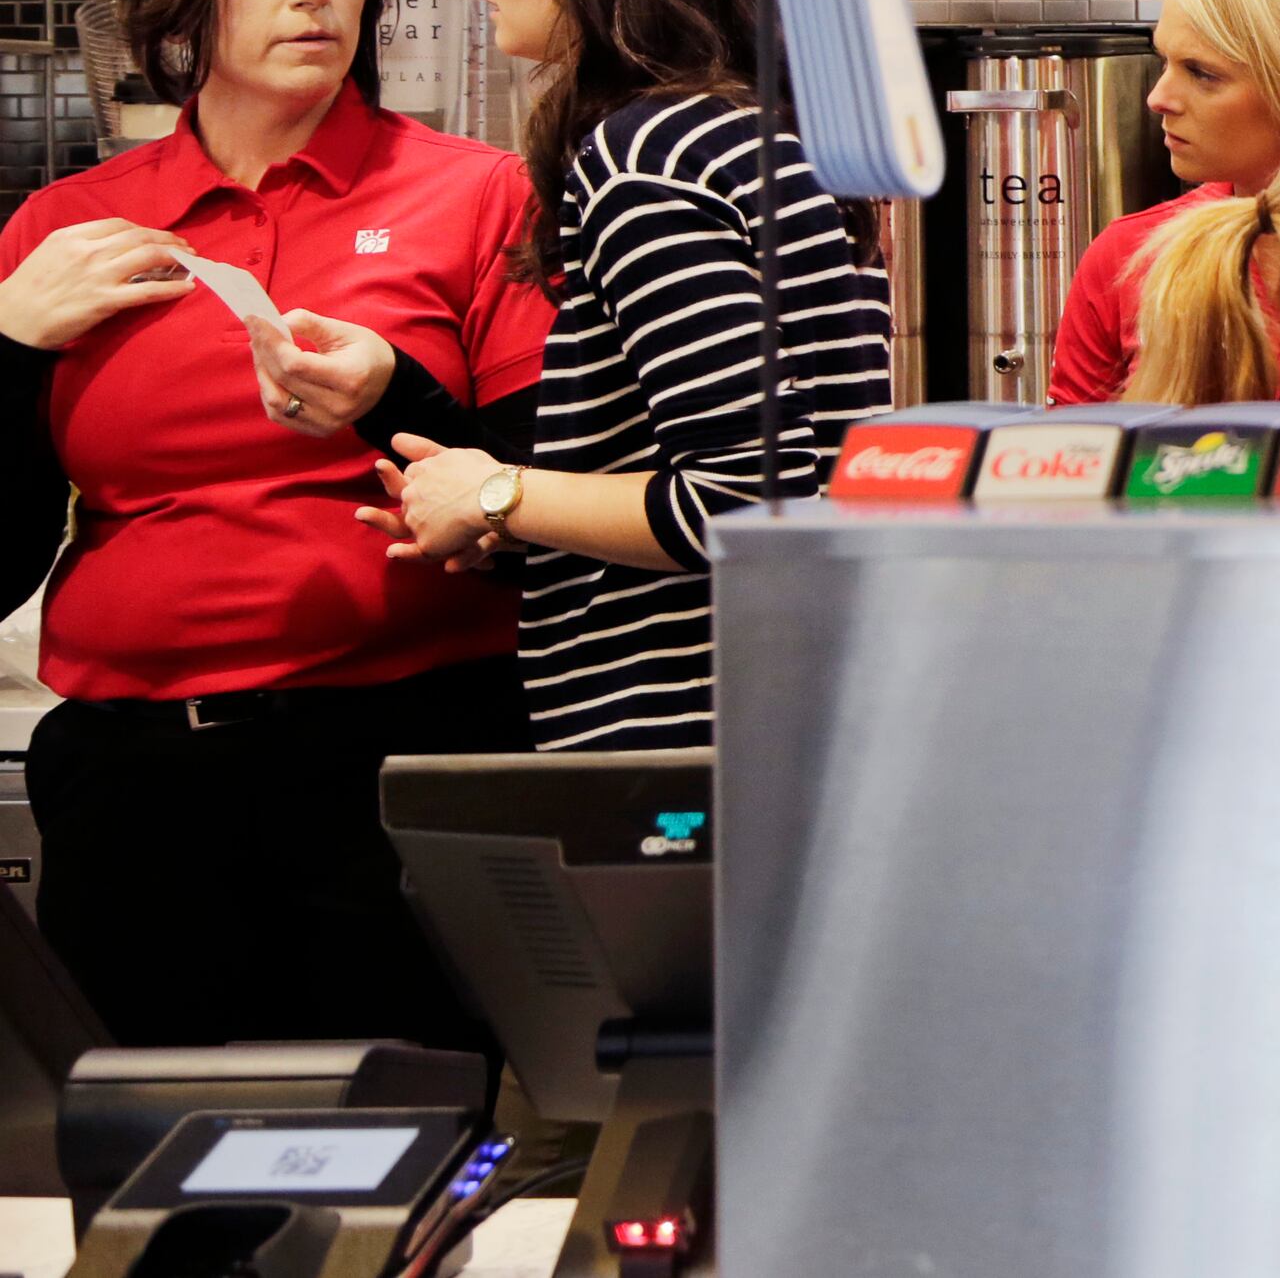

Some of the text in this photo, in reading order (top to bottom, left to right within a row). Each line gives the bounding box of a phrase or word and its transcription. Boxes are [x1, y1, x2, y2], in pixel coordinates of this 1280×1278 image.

[980, 167, 1065, 204] tea
[992, 448, 1101, 479] Coke
[1156, 442, 1240, 482] Sprite
